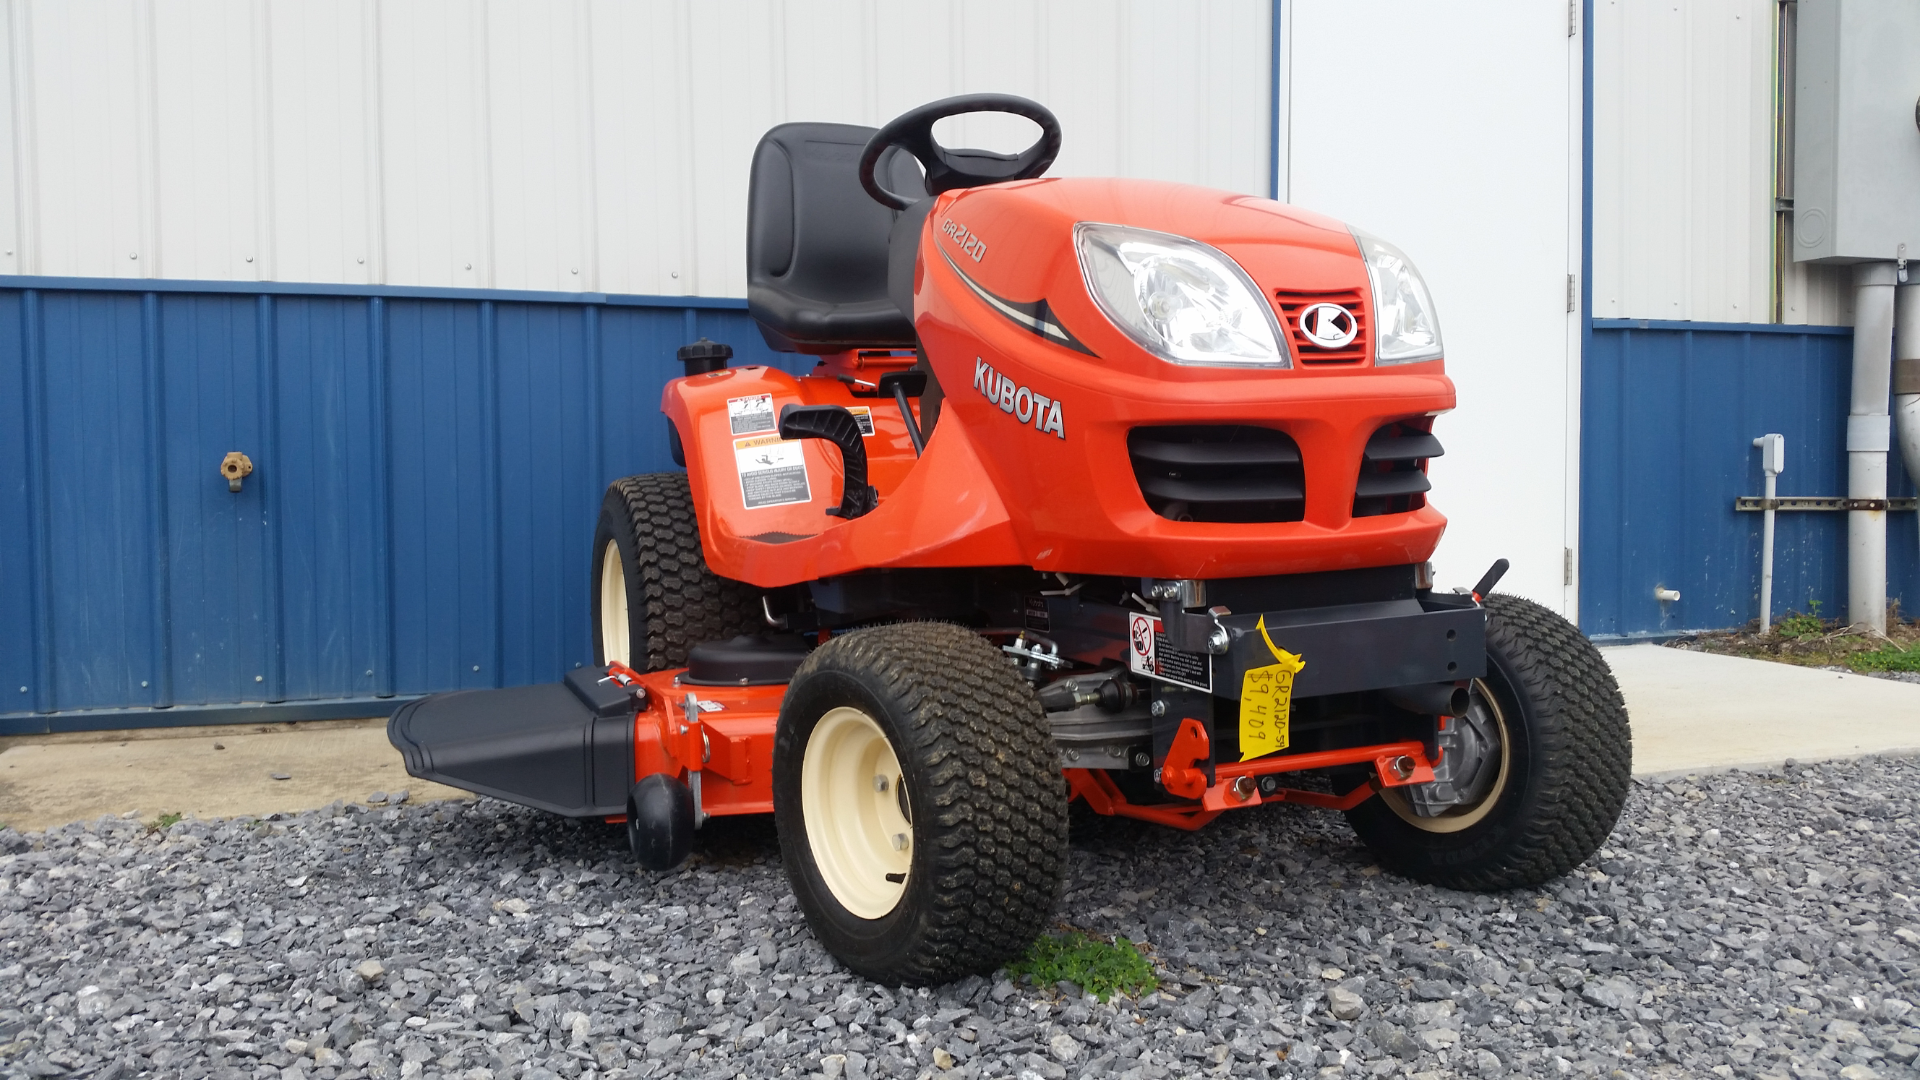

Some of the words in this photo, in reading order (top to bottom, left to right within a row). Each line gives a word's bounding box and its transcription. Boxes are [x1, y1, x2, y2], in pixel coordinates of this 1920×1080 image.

[942, 217, 988, 263] GR2120
[973, 355, 1066, 440] KUBOTA
[753, 436, 788, 446] WARNI
[1244, 670, 1273, 740] $9,409
